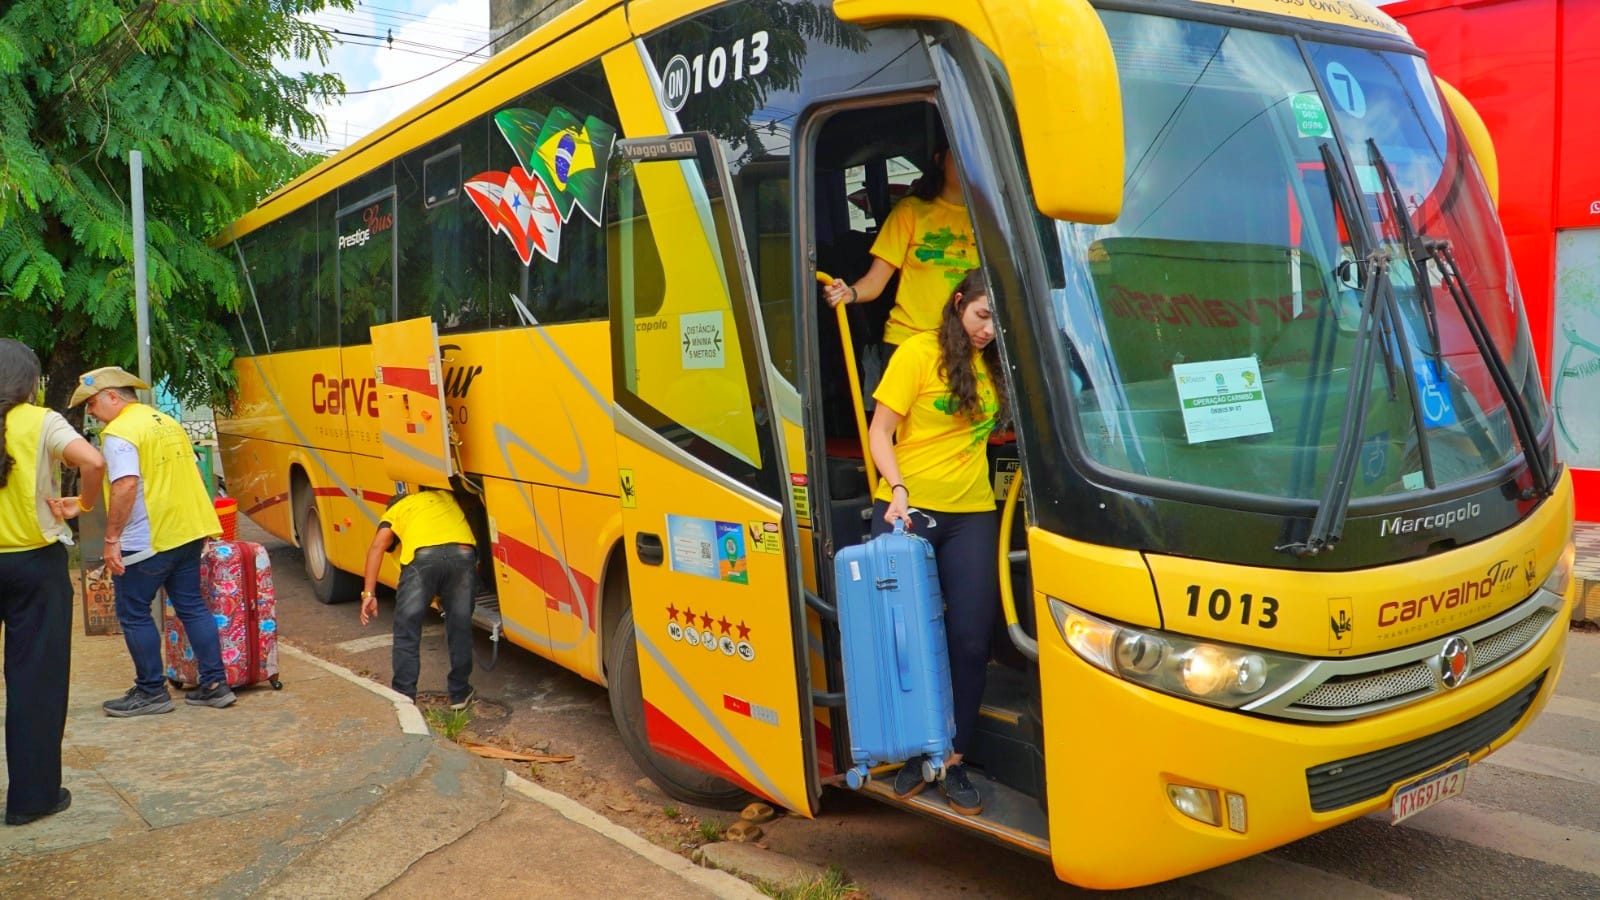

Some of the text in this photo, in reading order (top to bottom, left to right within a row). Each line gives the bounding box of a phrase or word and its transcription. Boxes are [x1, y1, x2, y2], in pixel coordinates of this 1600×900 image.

[692, 30, 769, 94] 1013
[668, 68, 684, 100] ON
[1332, 72, 1355, 111] 7
[624, 141, 693, 158] Viaggio 900
[338, 228, 370, 250] Prestige
[686, 323, 717, 335] DISTÂNCIA
[693, 349, 717, 359] METROS
[312, 373, 380, 418] Carva
[1380, 502, 1481, 537] Marcopolo
[1186, 584, 1280, 629] 1013
[1377, 559, 1519, 628] Carvalho Tur
[669, 625, 681, 635] WC
